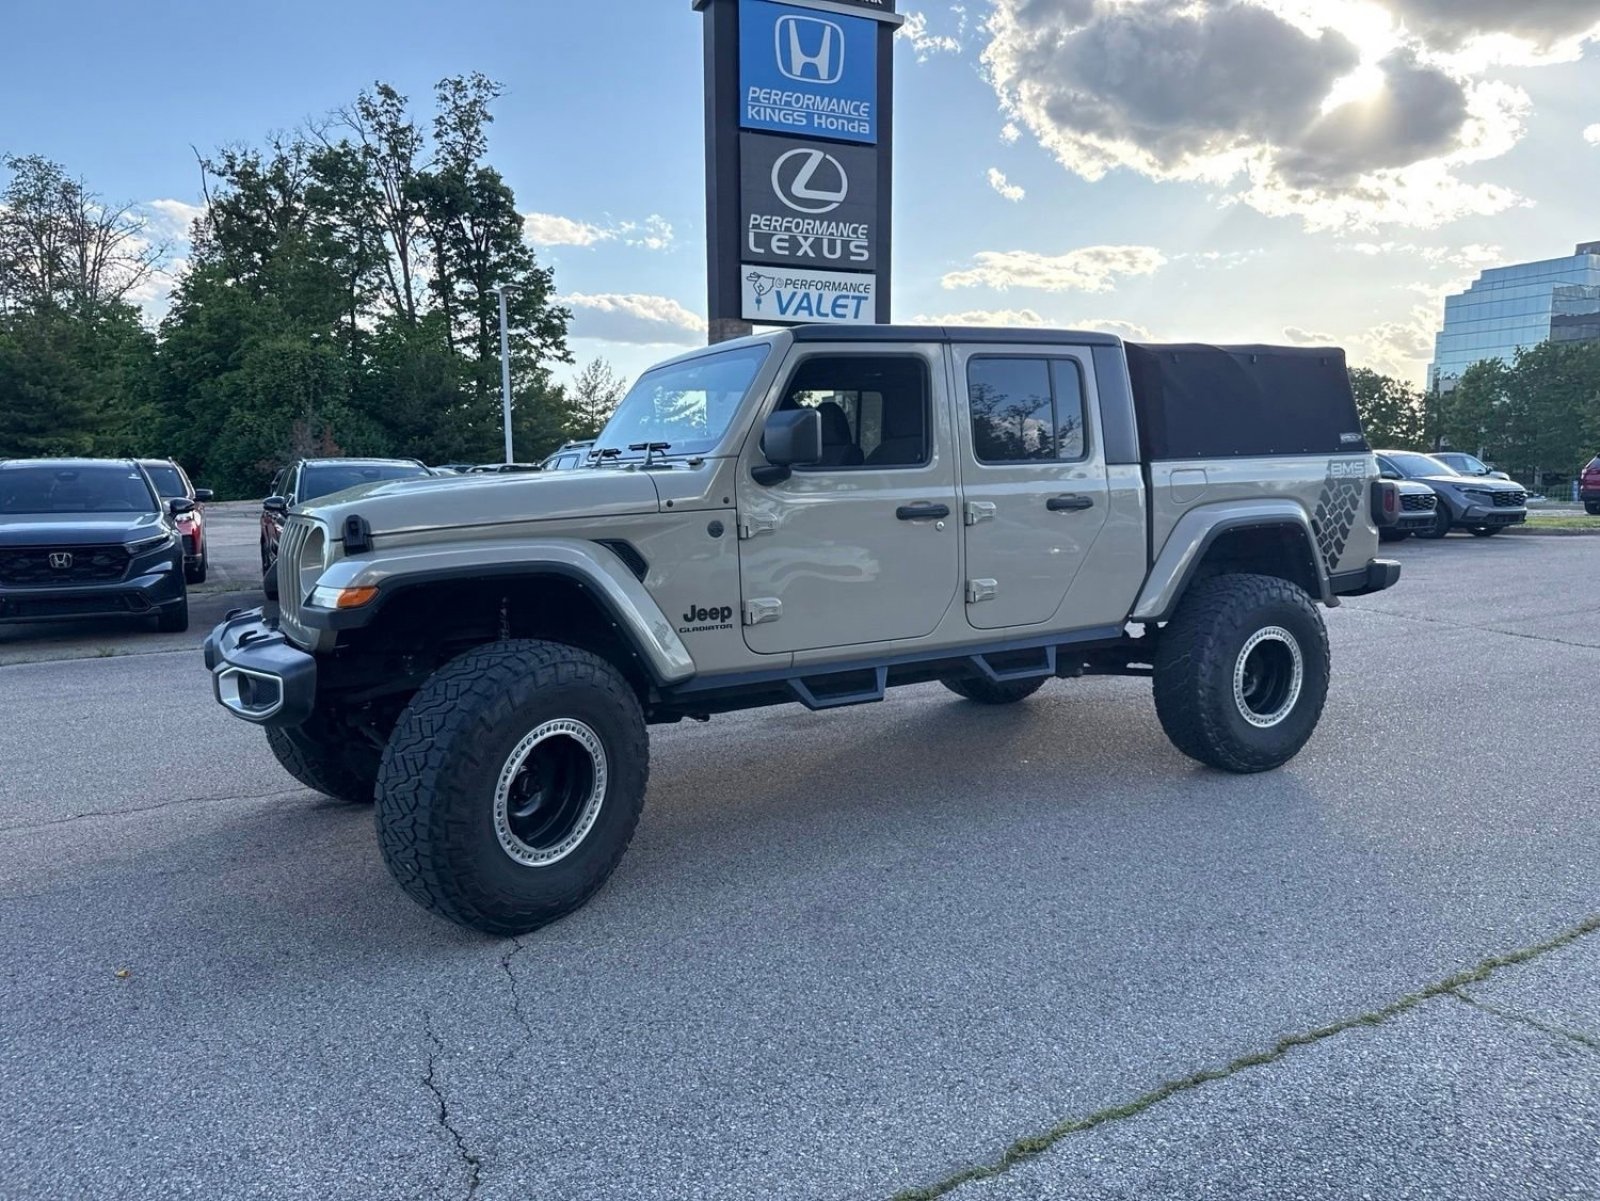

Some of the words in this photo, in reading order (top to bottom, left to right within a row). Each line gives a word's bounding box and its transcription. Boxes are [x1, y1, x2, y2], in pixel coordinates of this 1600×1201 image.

[748, 86, 871, 117] PERFORMANCE
[748, 105, 806, 126] KINGS
[814, 113, 870, 134] Honda
[749, 214, 869, 239] PERFORMANCE
[748, 231, 869, 261] LEXUS
[784, 278, 871, 294] PERFORMANCE
[775, 290, 869, 319] VALET
[683, 604, 732, 623] Jeep
[679, 623, 733, 633] GLADIATOR
